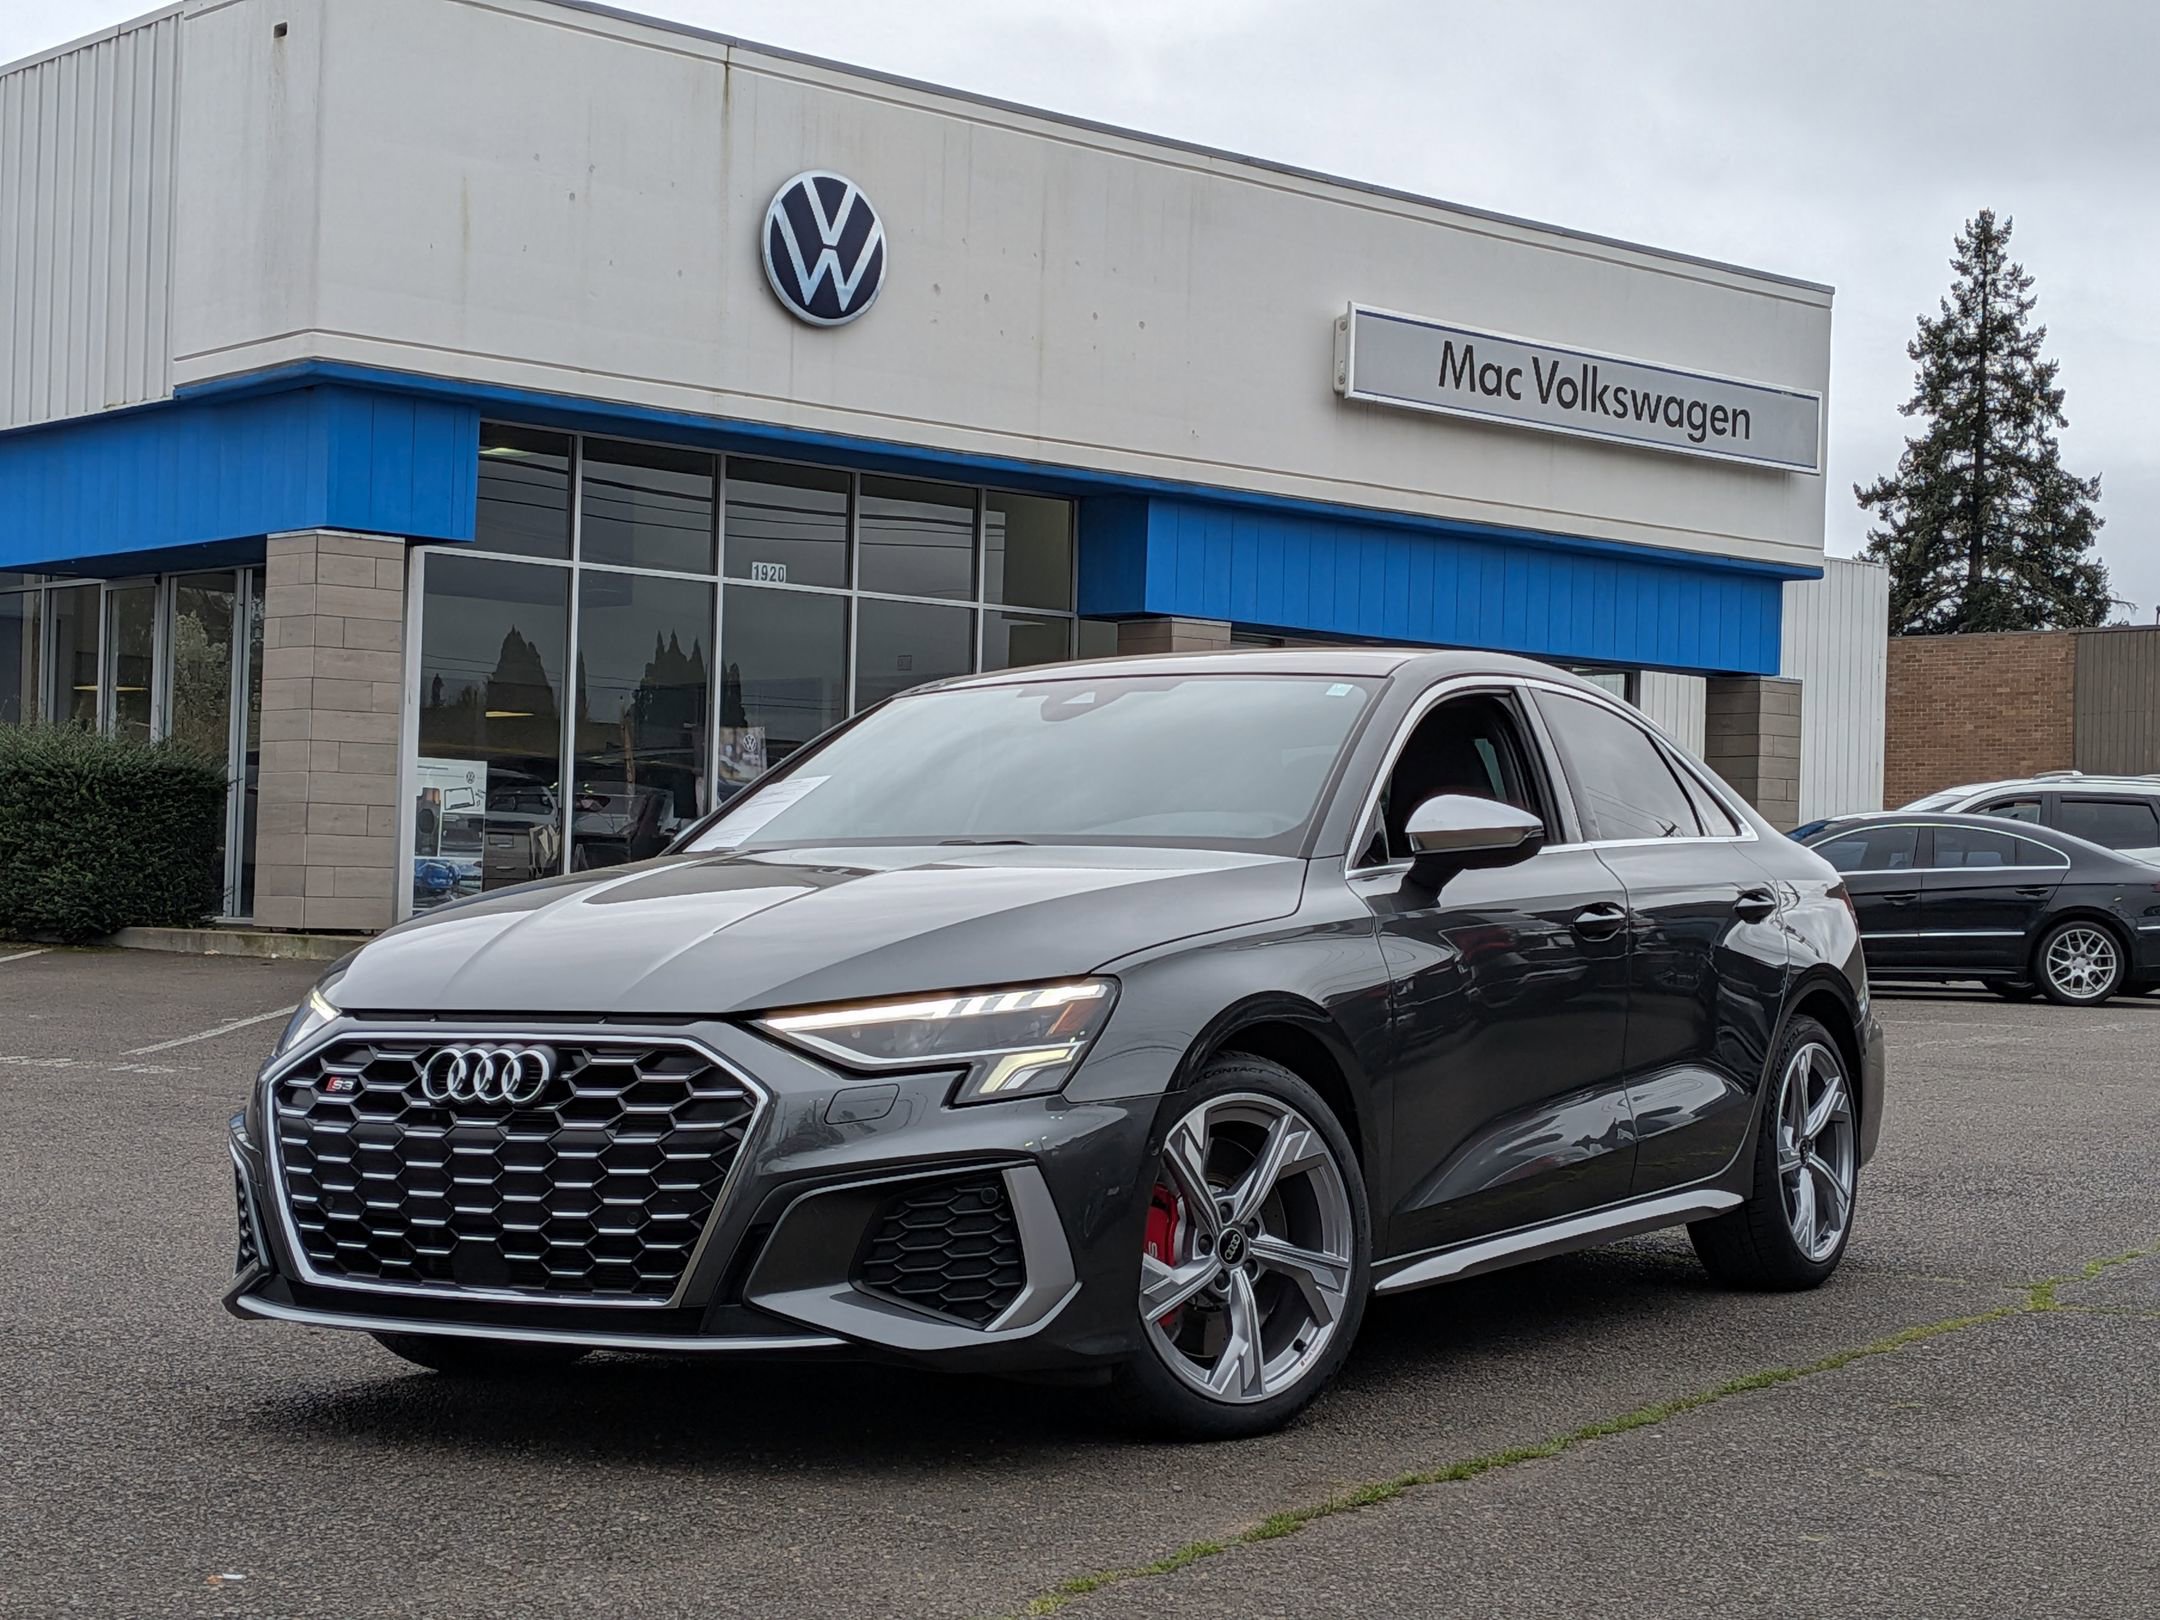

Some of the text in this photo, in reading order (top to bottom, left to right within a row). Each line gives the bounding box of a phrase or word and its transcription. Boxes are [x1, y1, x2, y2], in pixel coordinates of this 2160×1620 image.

[767, 174, 884, 319] VW
[1438, 340, 1751, 443] Mac Volkswagen
[753, 564, 785, 582] 1920
[331, 1079, 354, 1090] S3
